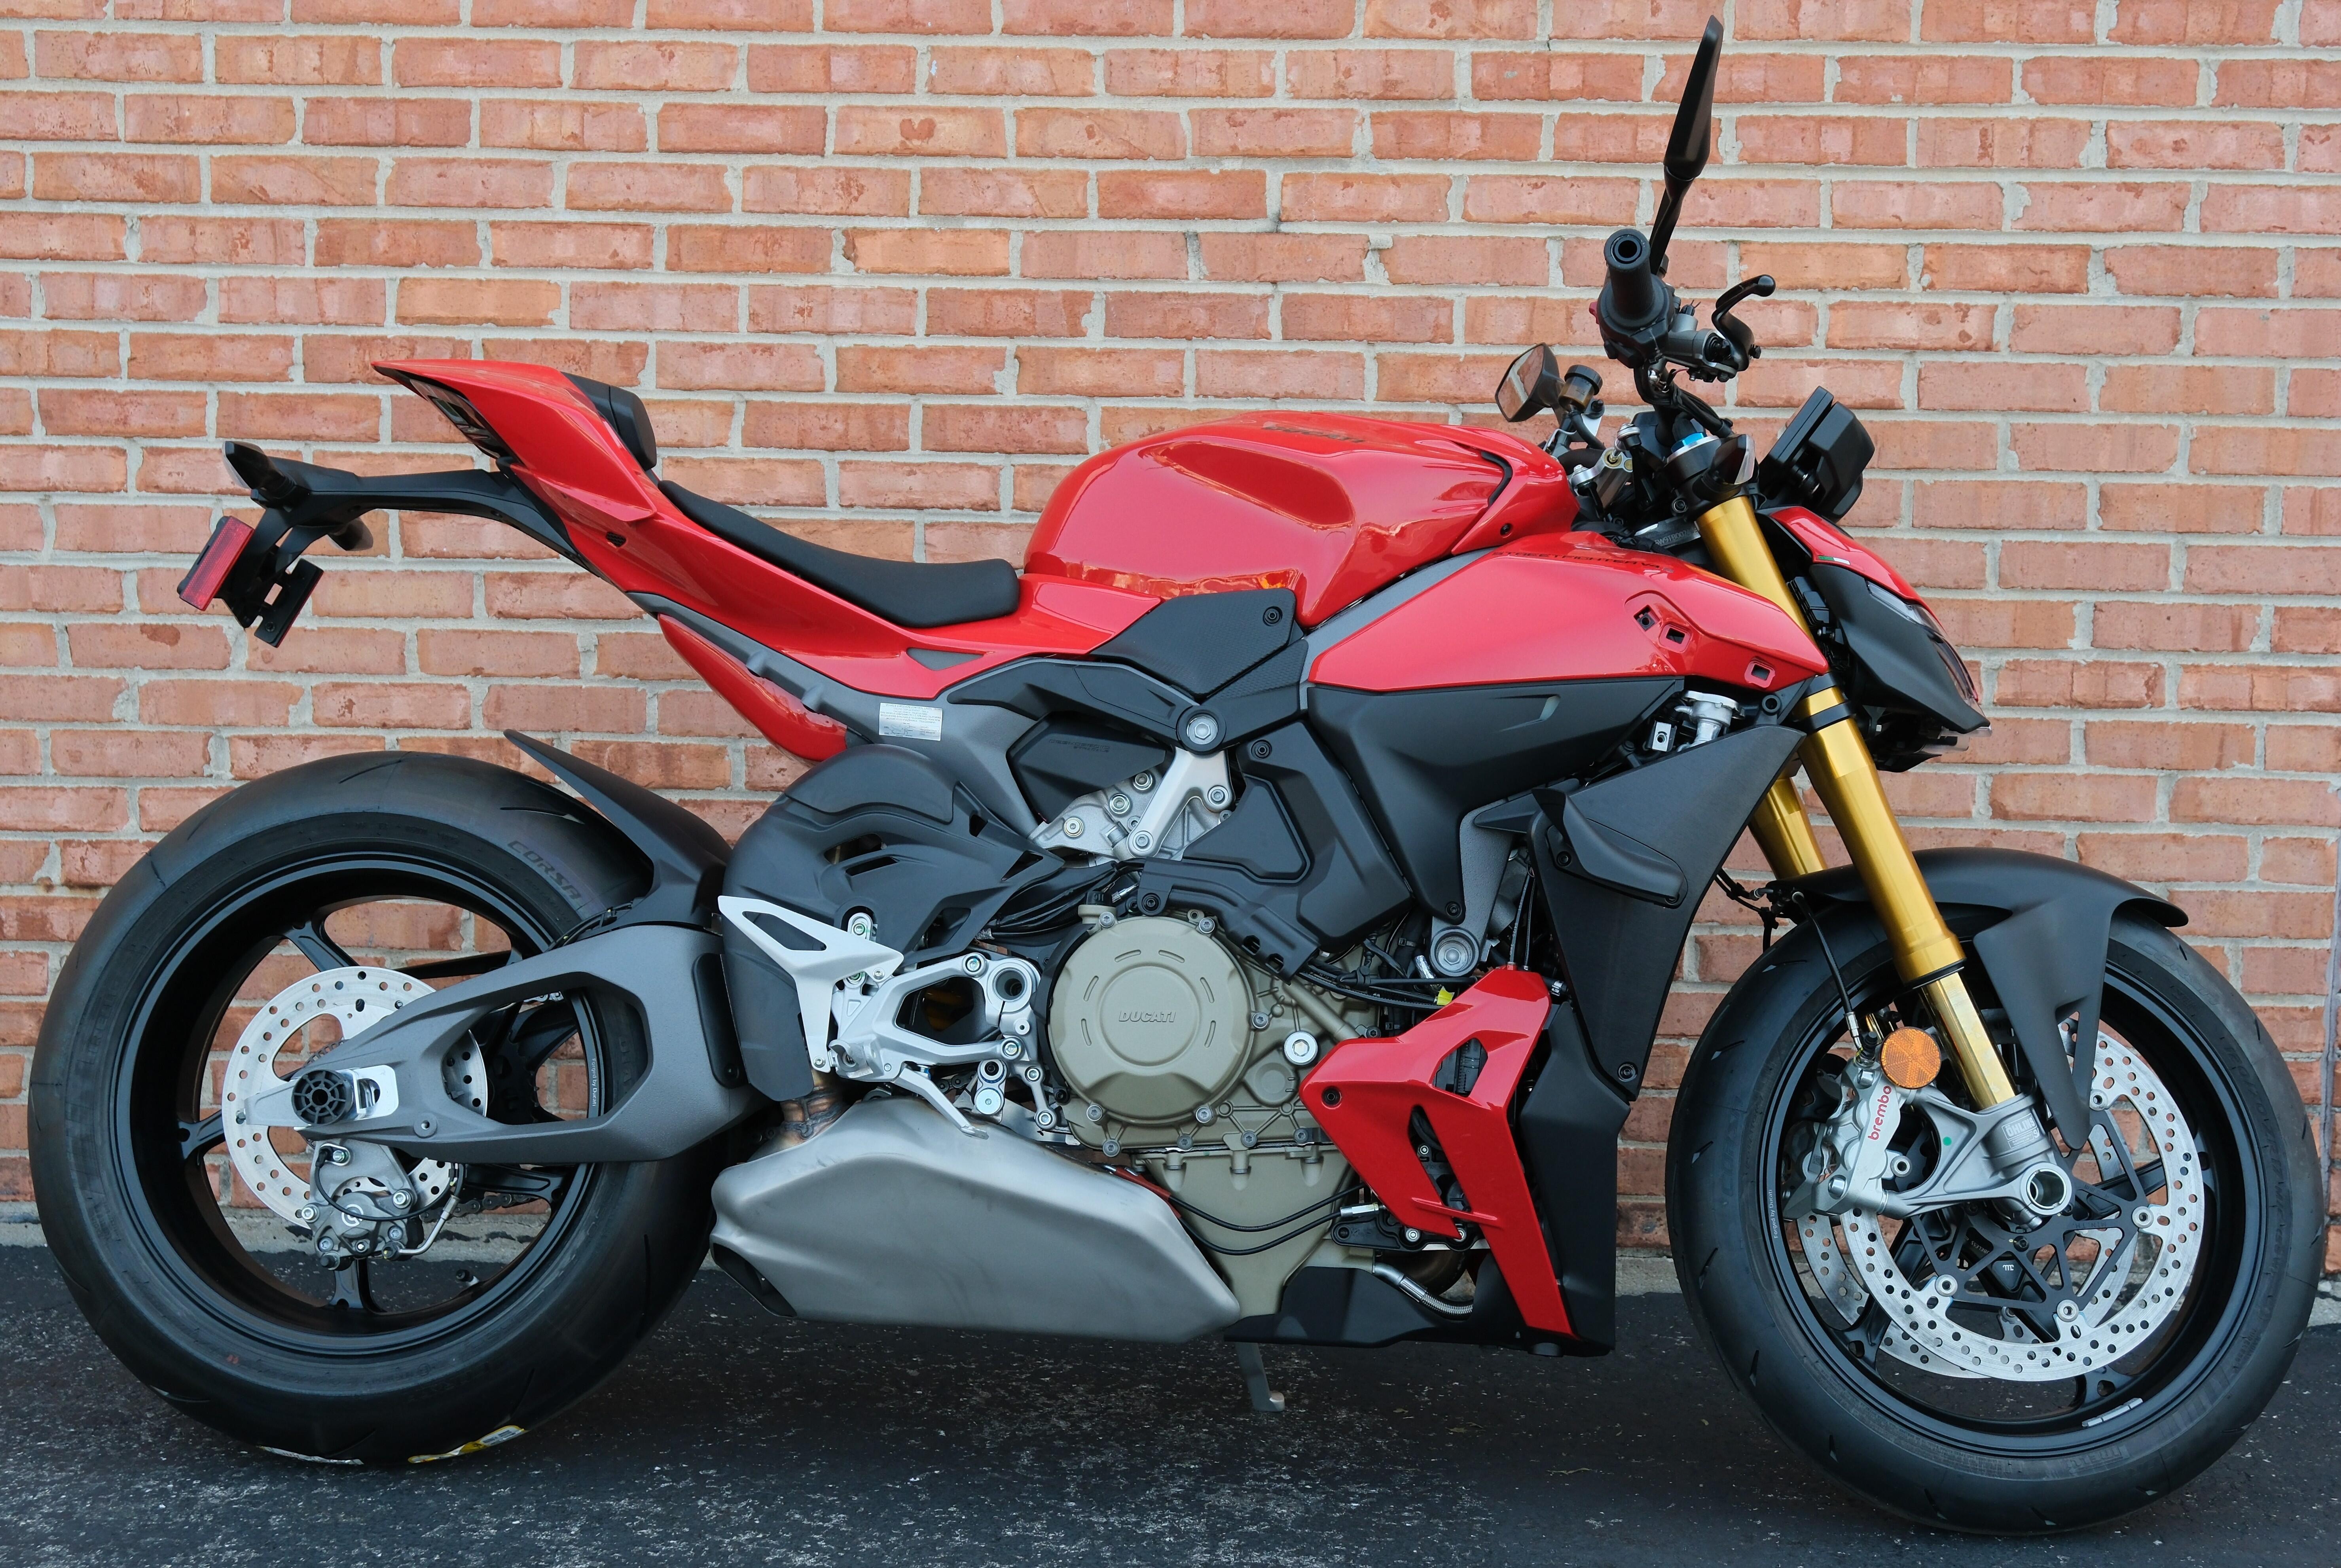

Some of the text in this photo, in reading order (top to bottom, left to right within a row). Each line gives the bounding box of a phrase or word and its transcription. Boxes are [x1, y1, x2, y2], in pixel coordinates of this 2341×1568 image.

[1492, 551, 1635, 564] STREETFIGHTER
[508, 840, 582, 899] CORSA
[1118, 1010, 1176, 1023] DUCATI
[1867, 1085, 1892, 1140] brembo
